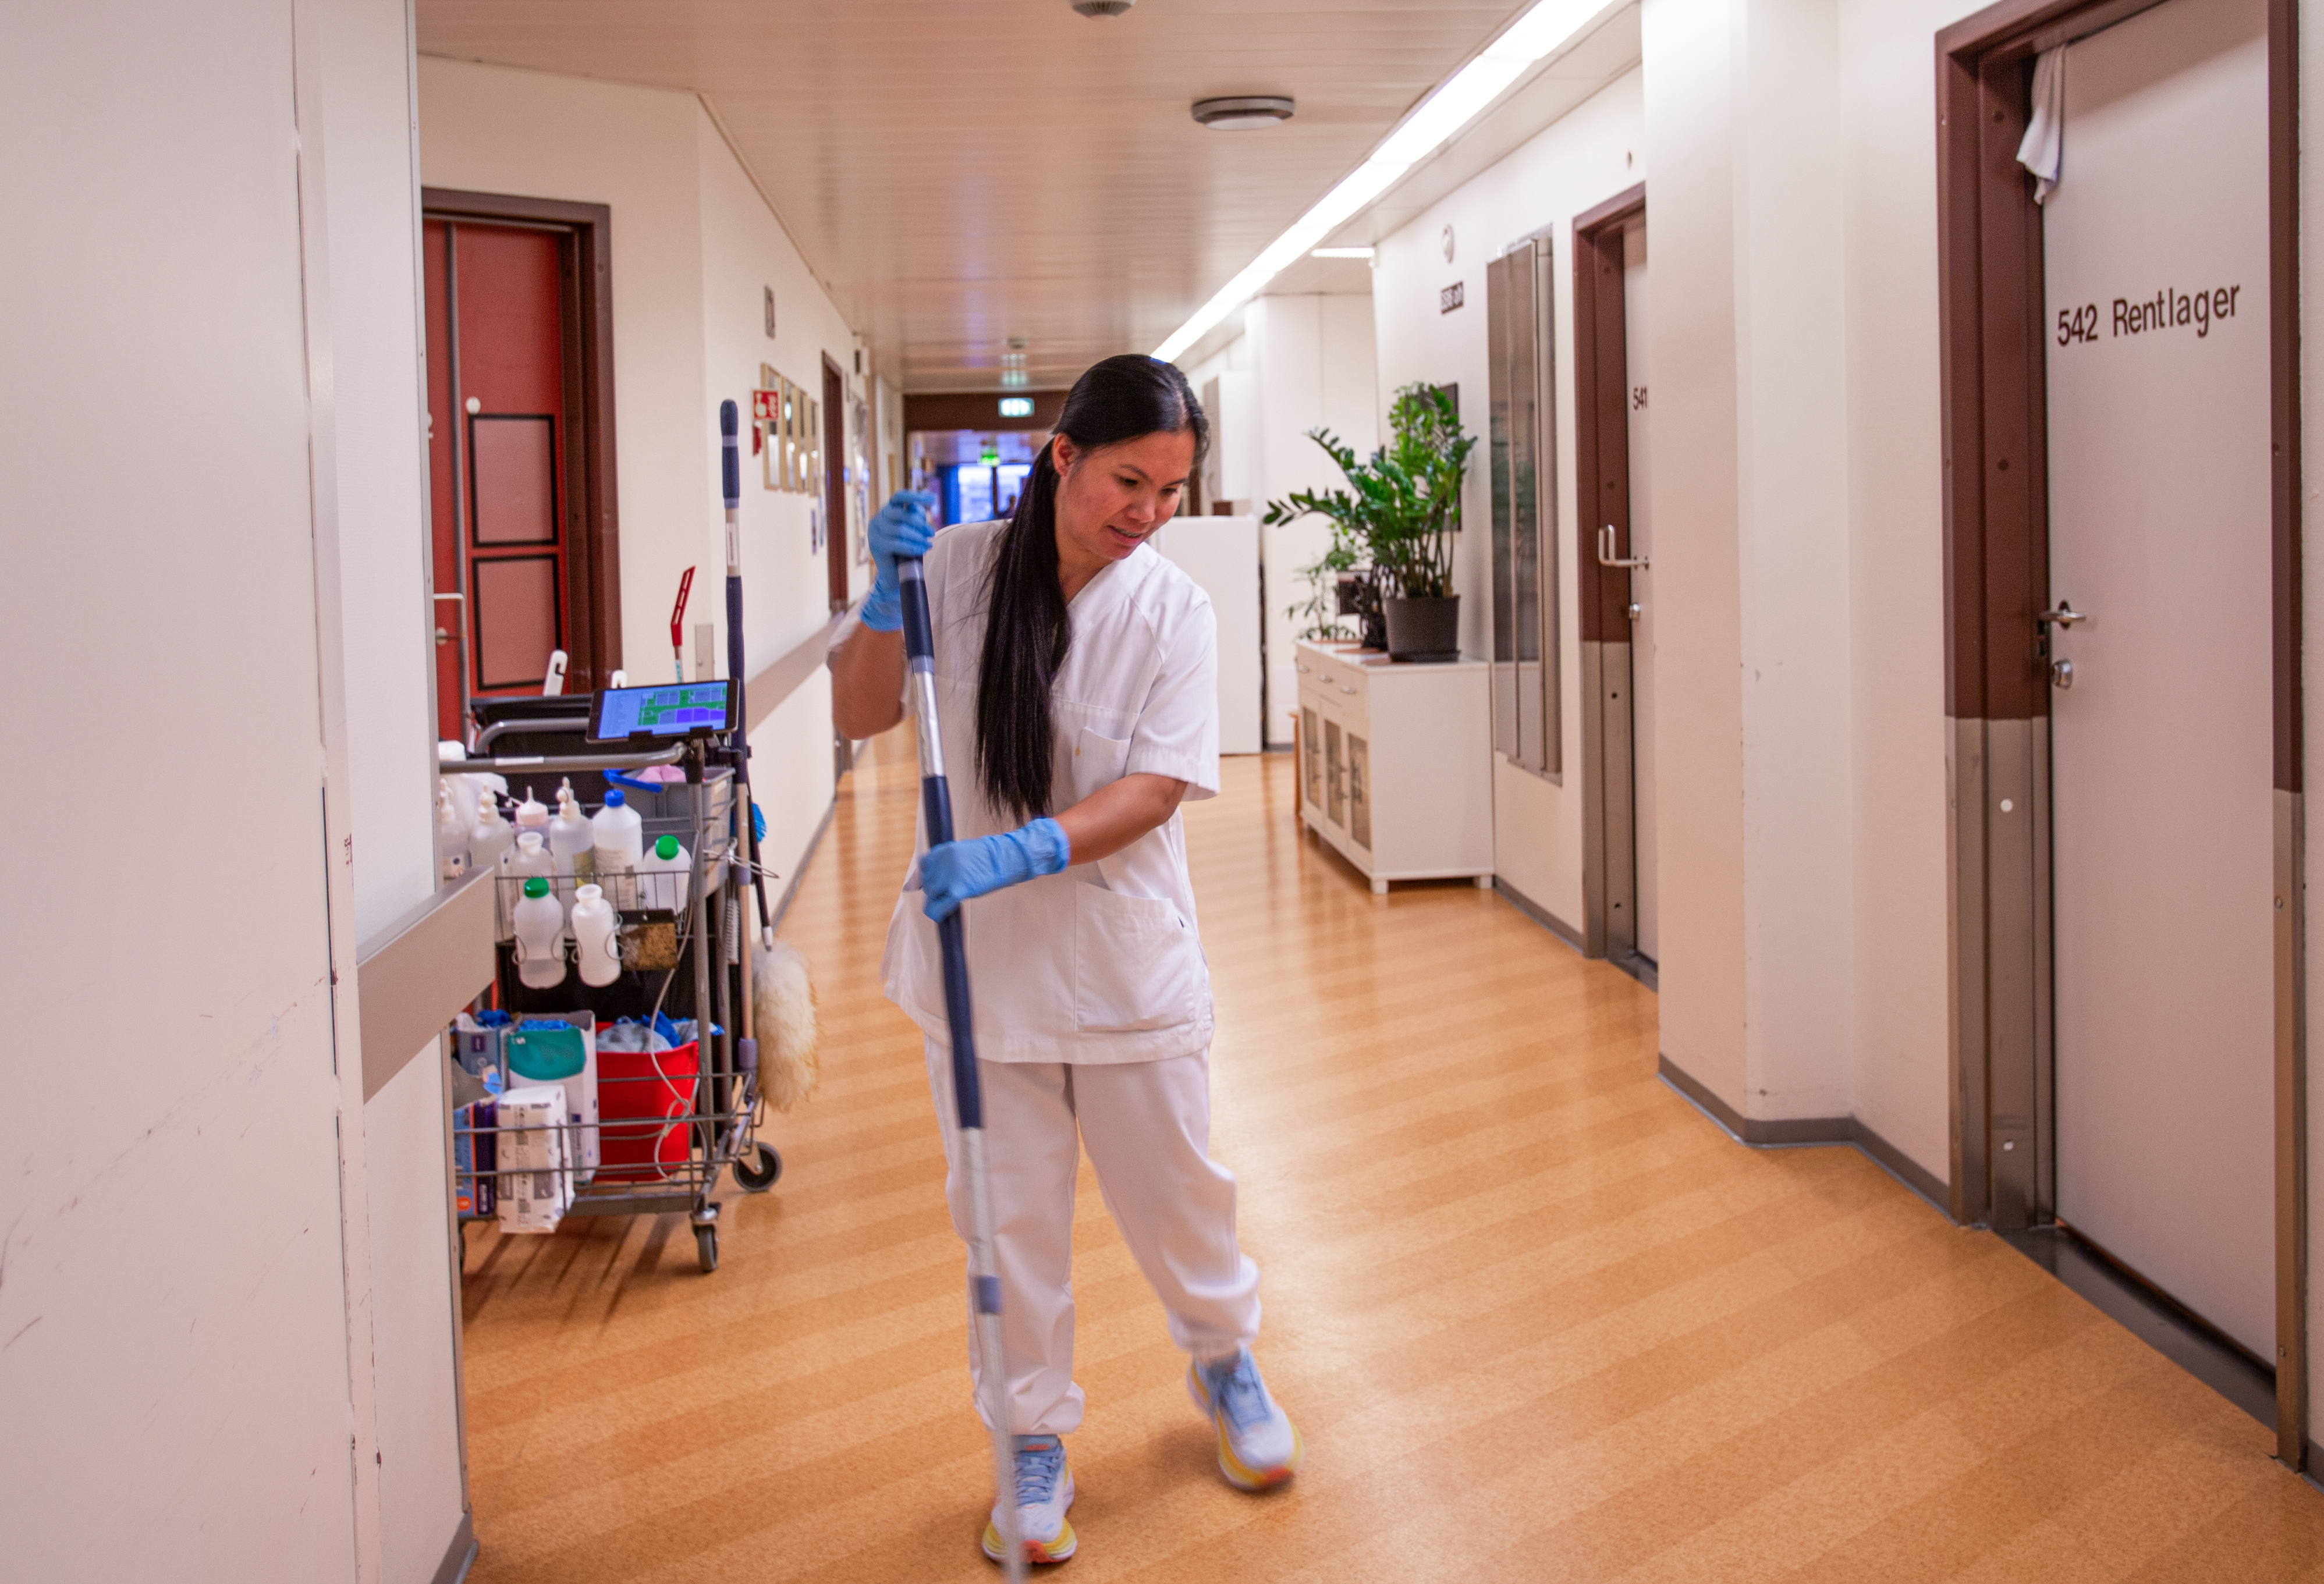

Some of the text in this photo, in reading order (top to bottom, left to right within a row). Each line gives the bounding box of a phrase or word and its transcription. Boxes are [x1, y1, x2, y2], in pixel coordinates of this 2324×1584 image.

[2057, 285, 2240, 347] 542 Rentlager
[1633, 386, 1647, 411] 541
